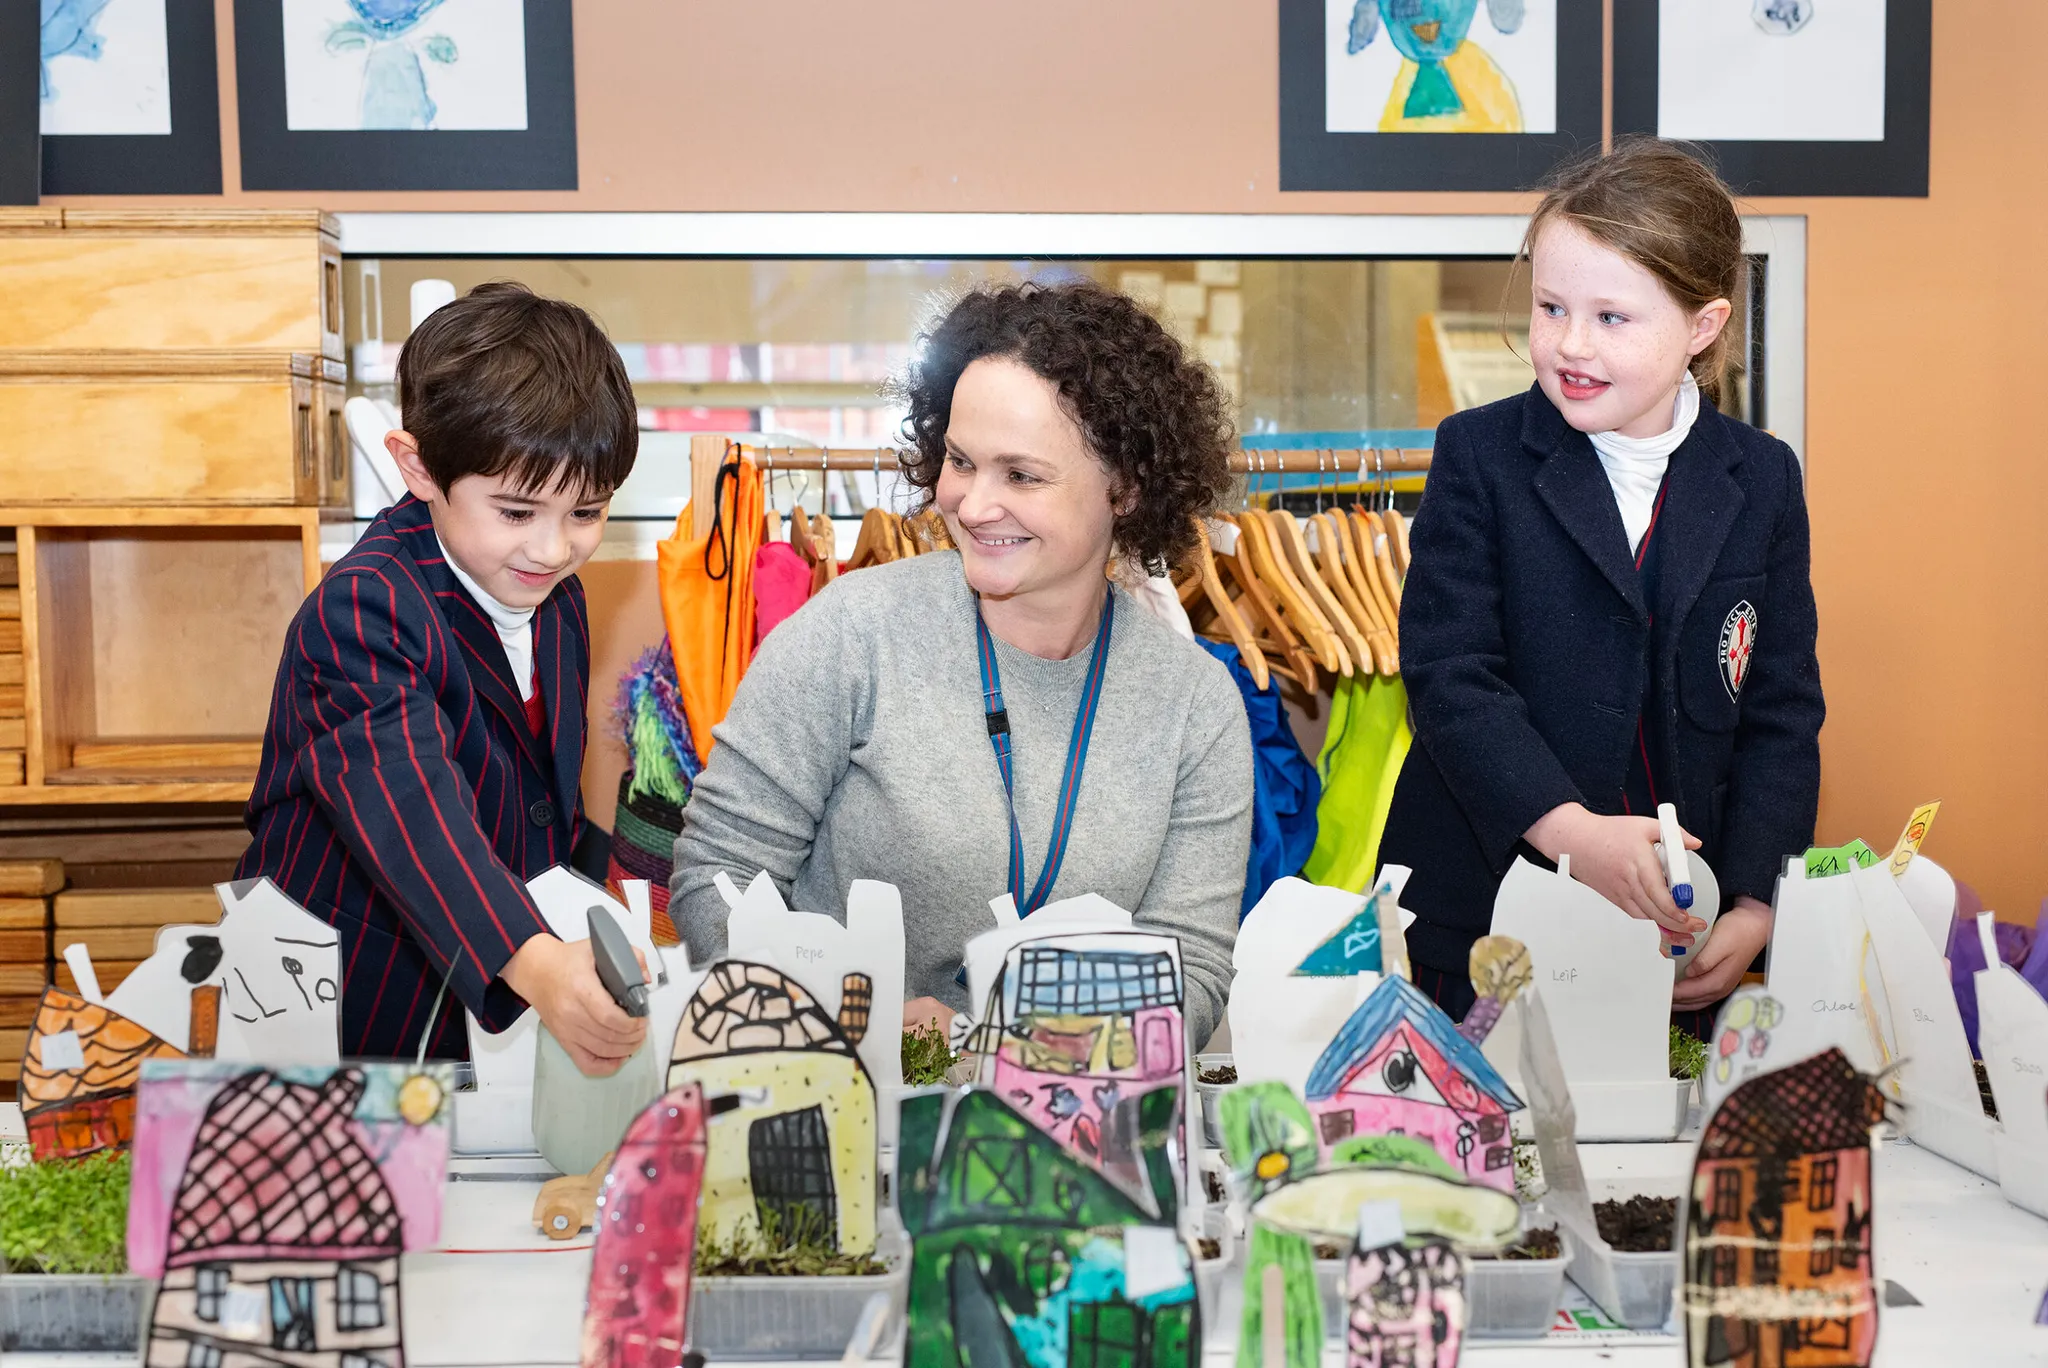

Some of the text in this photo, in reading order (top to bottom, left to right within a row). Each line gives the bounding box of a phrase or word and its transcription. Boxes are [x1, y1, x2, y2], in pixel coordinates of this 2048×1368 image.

[1720, 639, 1728, 664] PRO
[795, 945, 825, 964] Pepe
[1552, 967, 1578, 984] Leif
[1811, 999, 1856, 1013] Chloe
